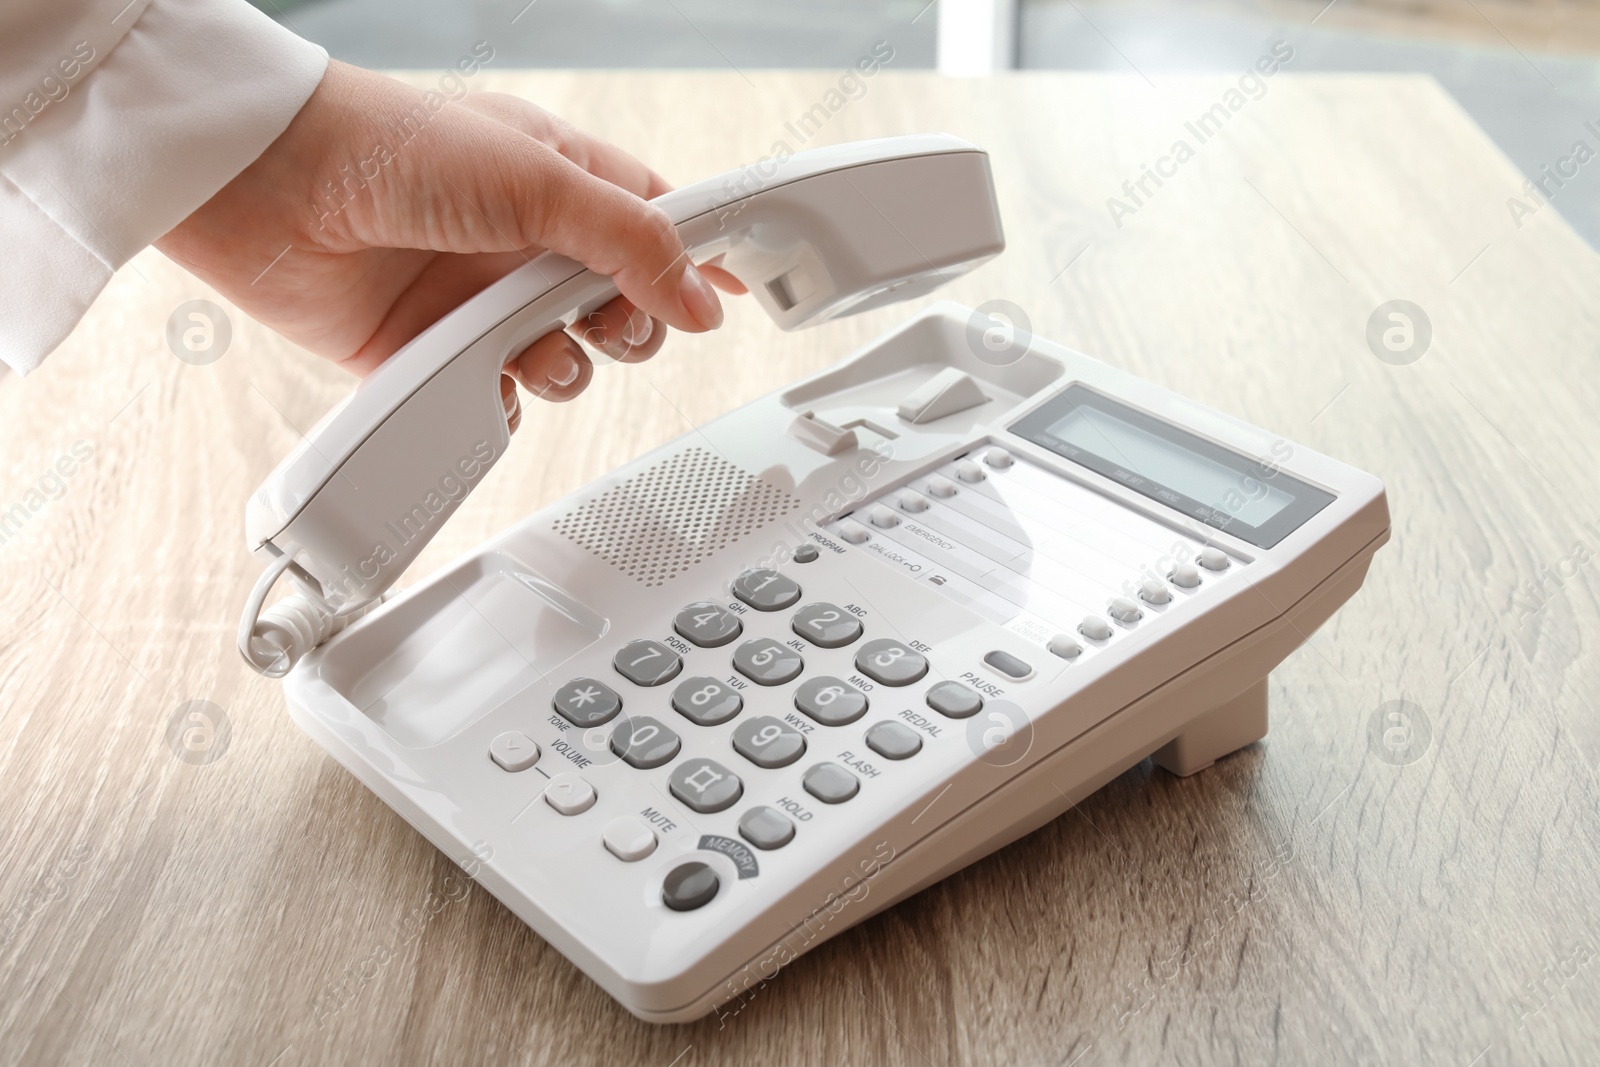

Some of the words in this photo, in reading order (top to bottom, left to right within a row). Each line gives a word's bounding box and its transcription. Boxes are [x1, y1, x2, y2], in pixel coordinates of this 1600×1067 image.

[808, 532, 847, 555] PROGRAM
[904, 524, 957, 551] EMERGENCY
[868, 543, 886, 558] DIAL
[883, 551, 907, 564] LOCK
[753, 576, 779, 592] 1
[728, 602, 748, 616] GHI
[844, 603, 868, 618] ABC
[692, 612, 720, 629] 4
[808, 610, 841, 630] 2
[664, 635, 692, 655] PQRS
[786, 639, 808, 653] JKL
[908, 640, 933, 655] DEF
[630, 647, 662, 667] 7
[751, 646, 783, 666] 5
[875, 647, 906, 667] 3
[726, 676, 749, 691] TUV
[848, 675, 874, 692] MNO
[959, 671, 1005, 698] PAUSE
[691, 685, 721, 705] 8
[814, 685, 845, 706] 6
[547, 715, 571, 732] TONE
[783, 712, 815, 735] WXYZ
[898, 709, 943, 738] REDIAL
[630, 725, 660, 746] 0
[751, 724, 782, 747] 9
[551, 738, 593, 769] VOLUME
[837, 751, 882, 779] FLASH
[776, 796, 814, 823] HOLD
[640, 806, 678, 834] MUTE
[706, 836, 757, 872] MEMORY
